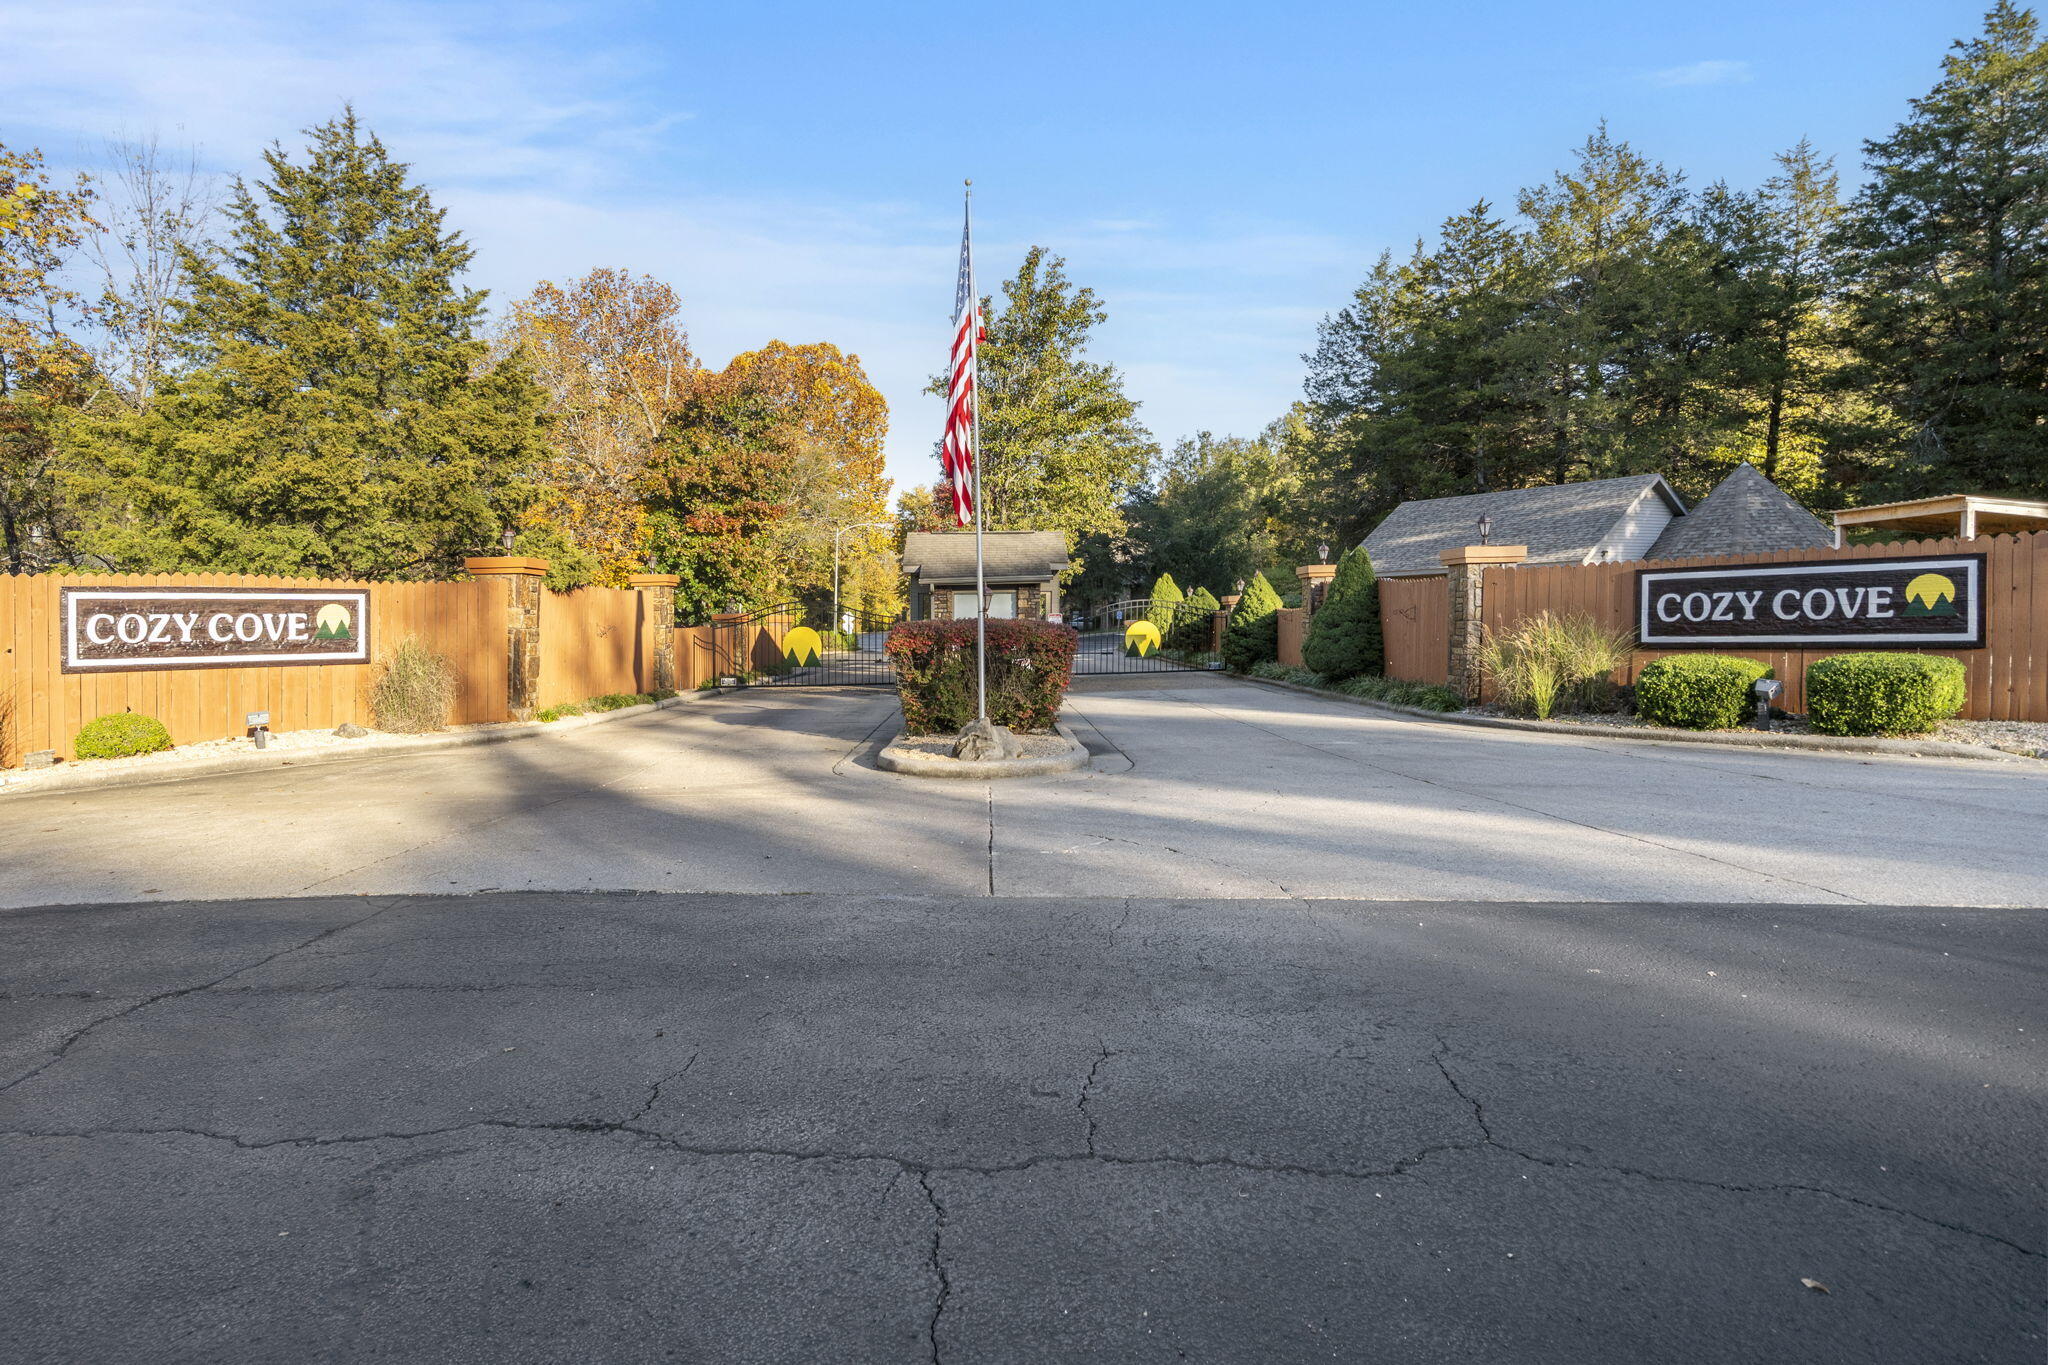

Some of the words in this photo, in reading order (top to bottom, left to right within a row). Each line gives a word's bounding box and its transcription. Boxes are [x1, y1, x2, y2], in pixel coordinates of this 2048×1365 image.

[1656, 590, 1763, 622] COZY
[1772, 586, 1894, 620] COVE
[86, 613, 200, 644] COZY
[208, 612, 308, 642] COVE
